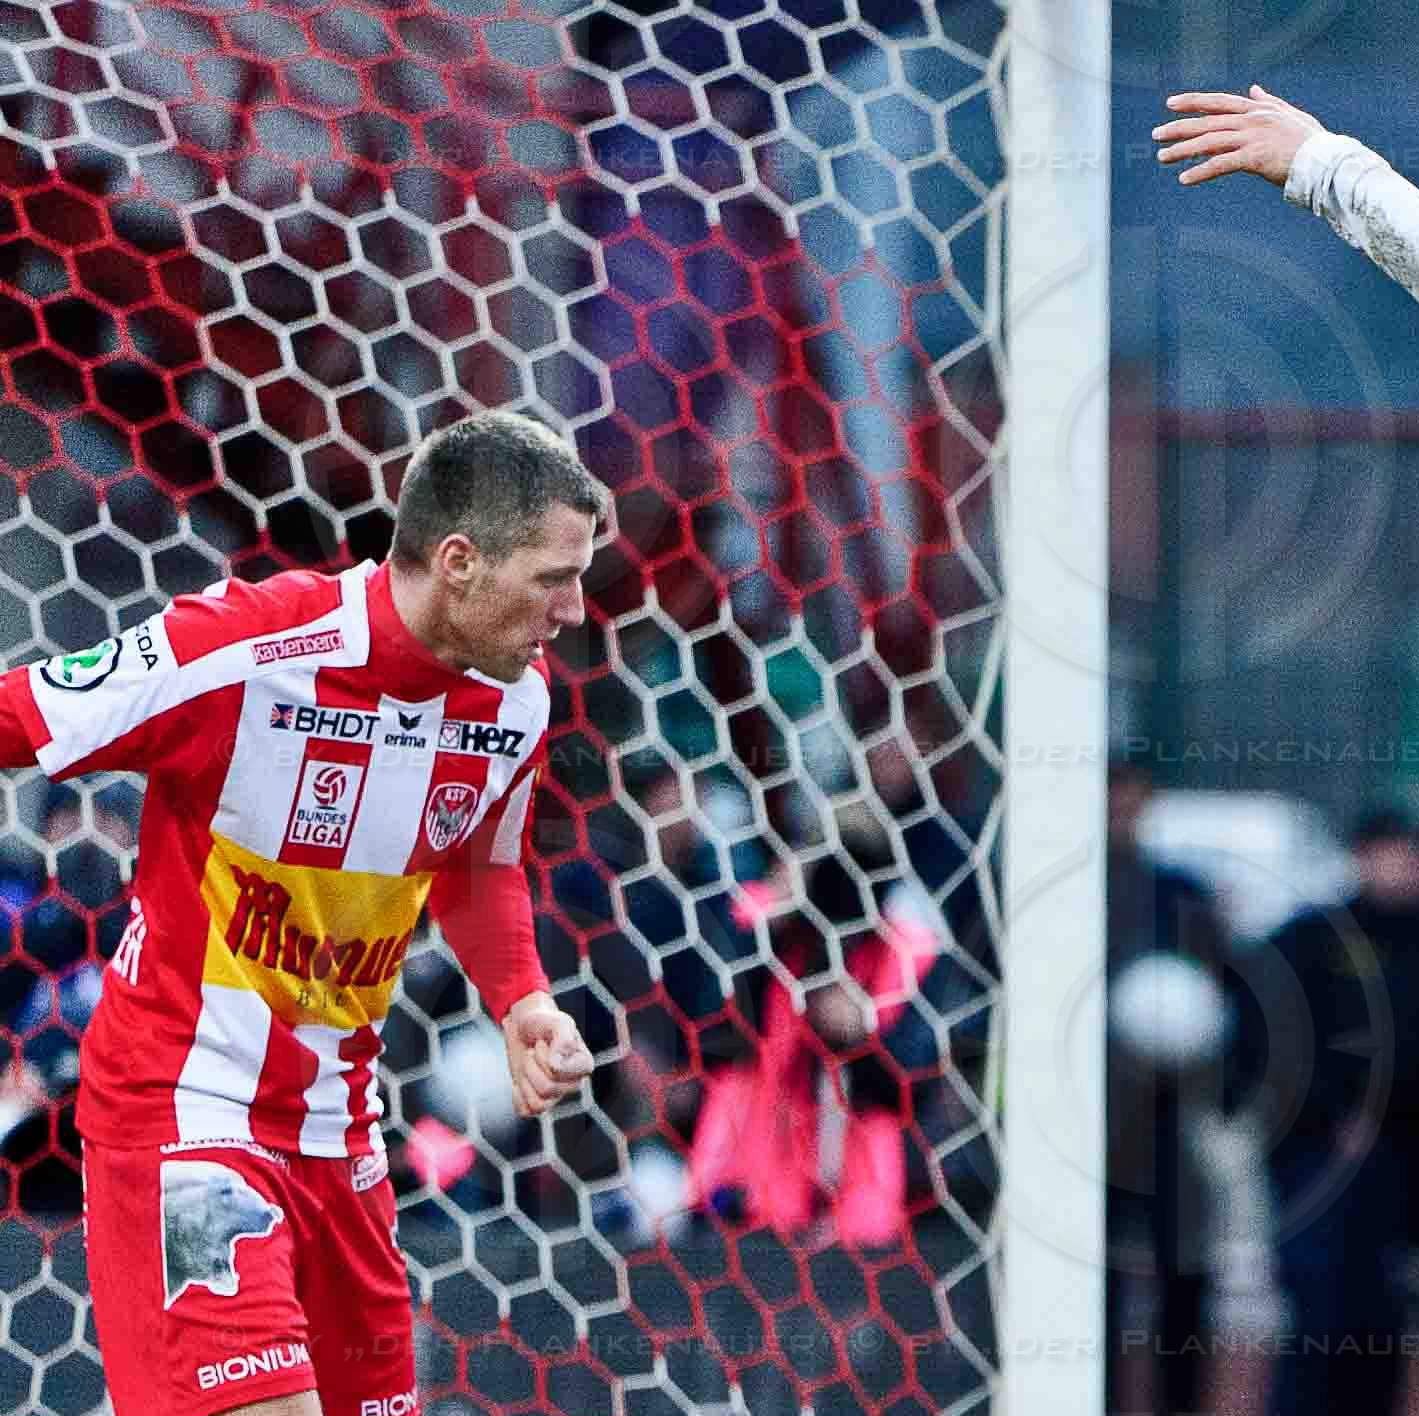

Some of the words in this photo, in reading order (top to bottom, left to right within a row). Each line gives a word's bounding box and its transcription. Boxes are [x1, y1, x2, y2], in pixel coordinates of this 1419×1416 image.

[294, 705, 380, 740] BHDT
[384, 732, 427, 750] erima
[291, 822, 343, 845] LIGA
